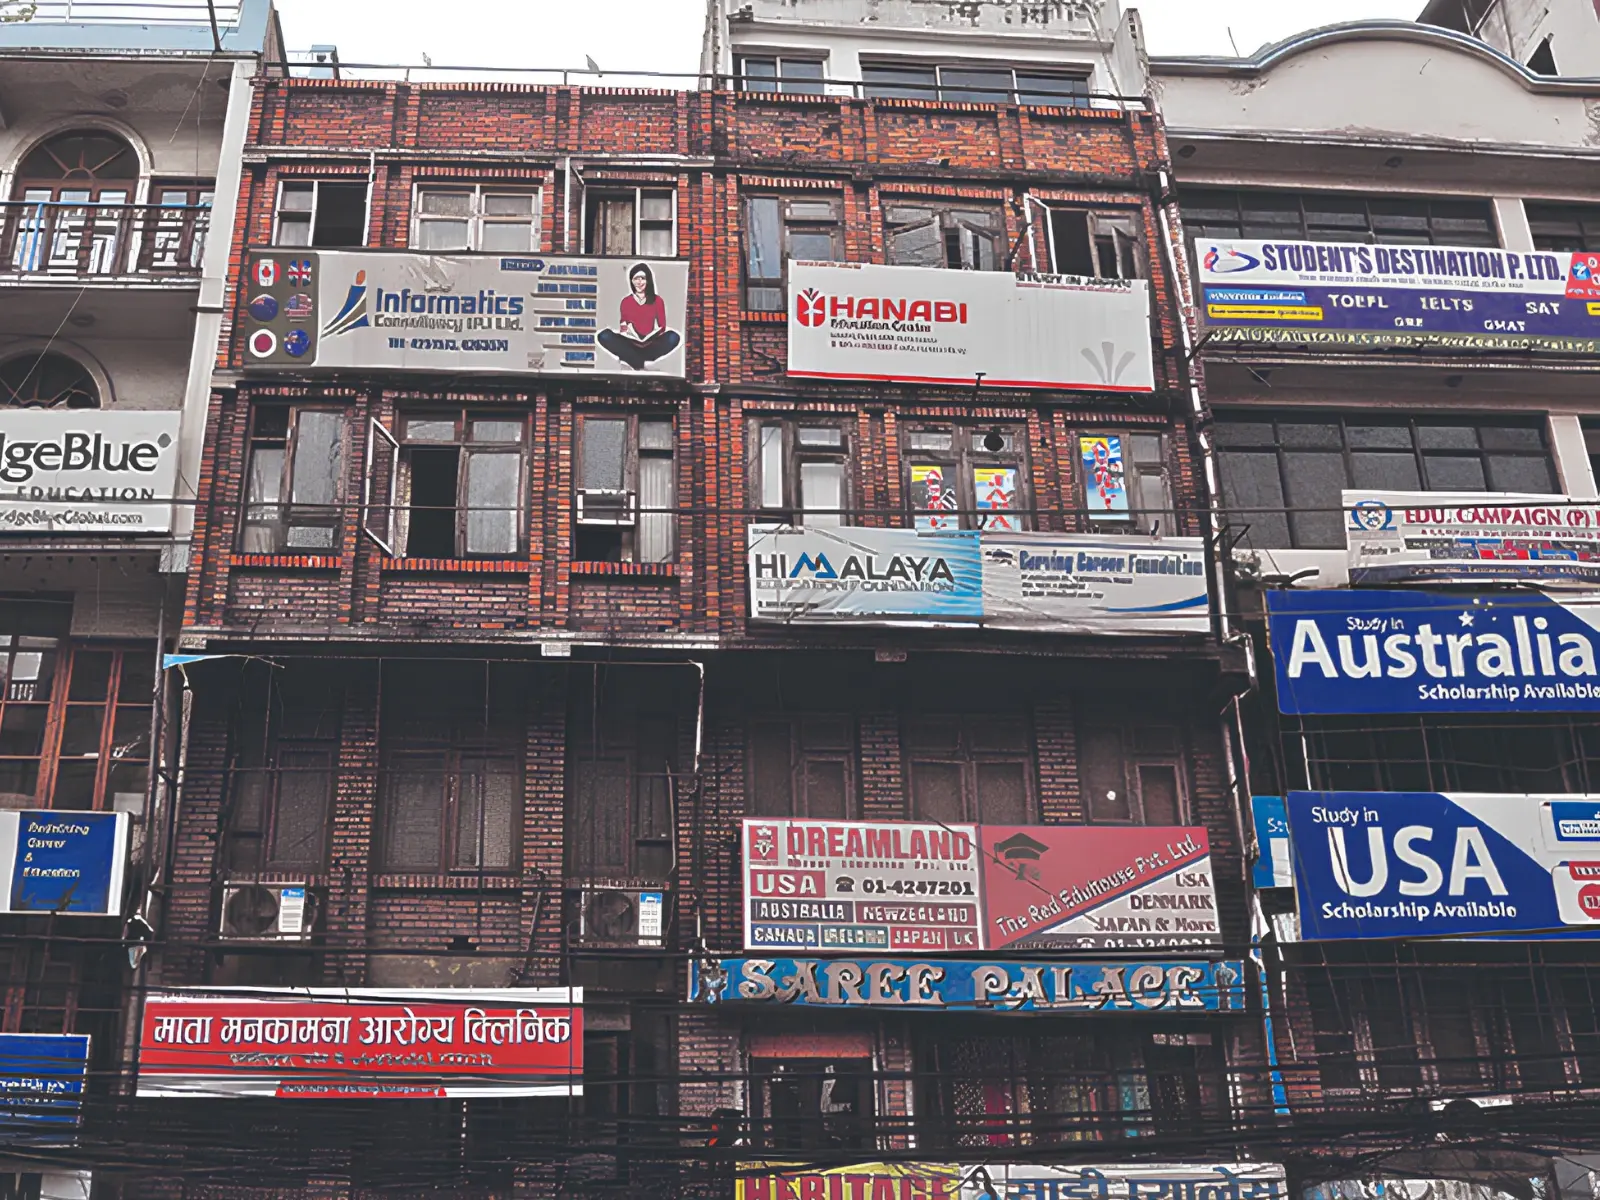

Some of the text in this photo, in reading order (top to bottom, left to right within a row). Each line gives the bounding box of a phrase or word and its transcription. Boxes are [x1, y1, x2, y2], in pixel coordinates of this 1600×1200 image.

[1262, 243, 1372, 274] STUDENT'S
[1375, 247, 1505, 279] DESTINATION
[376, 287, 524, 316] Informatics
[829, 296, 967, 324] HANABI
[1328, 294, 1560, 315] TOEFL IELTS SAT
[1484, 319, 1526, 332] GMAT
[17, 486, 156, 501] EDUCATION
[1456, 508, 1562, 526] CAMPAIGN
[755, 551, 955, 582] HIMALAYA
[1288, 614, 1598, 678] Australia
[1418, 683, 1520, 701] Scholarship
[1311, 806, 1359, 826] Study
[1364, 806, 1378, 822] in
[787, 826, 972, 860] DREAMLAND
[1326, 825, 1510, 896] USA
[757, 873, 817, 894] USA
[1321, 902, 1517, 922] Scholarship Available
[754, 926, 816, 943] CANADA
[738, 959, 1204, 1008] SAREE PALACE
[154, 1016, 214, 1044] माता
